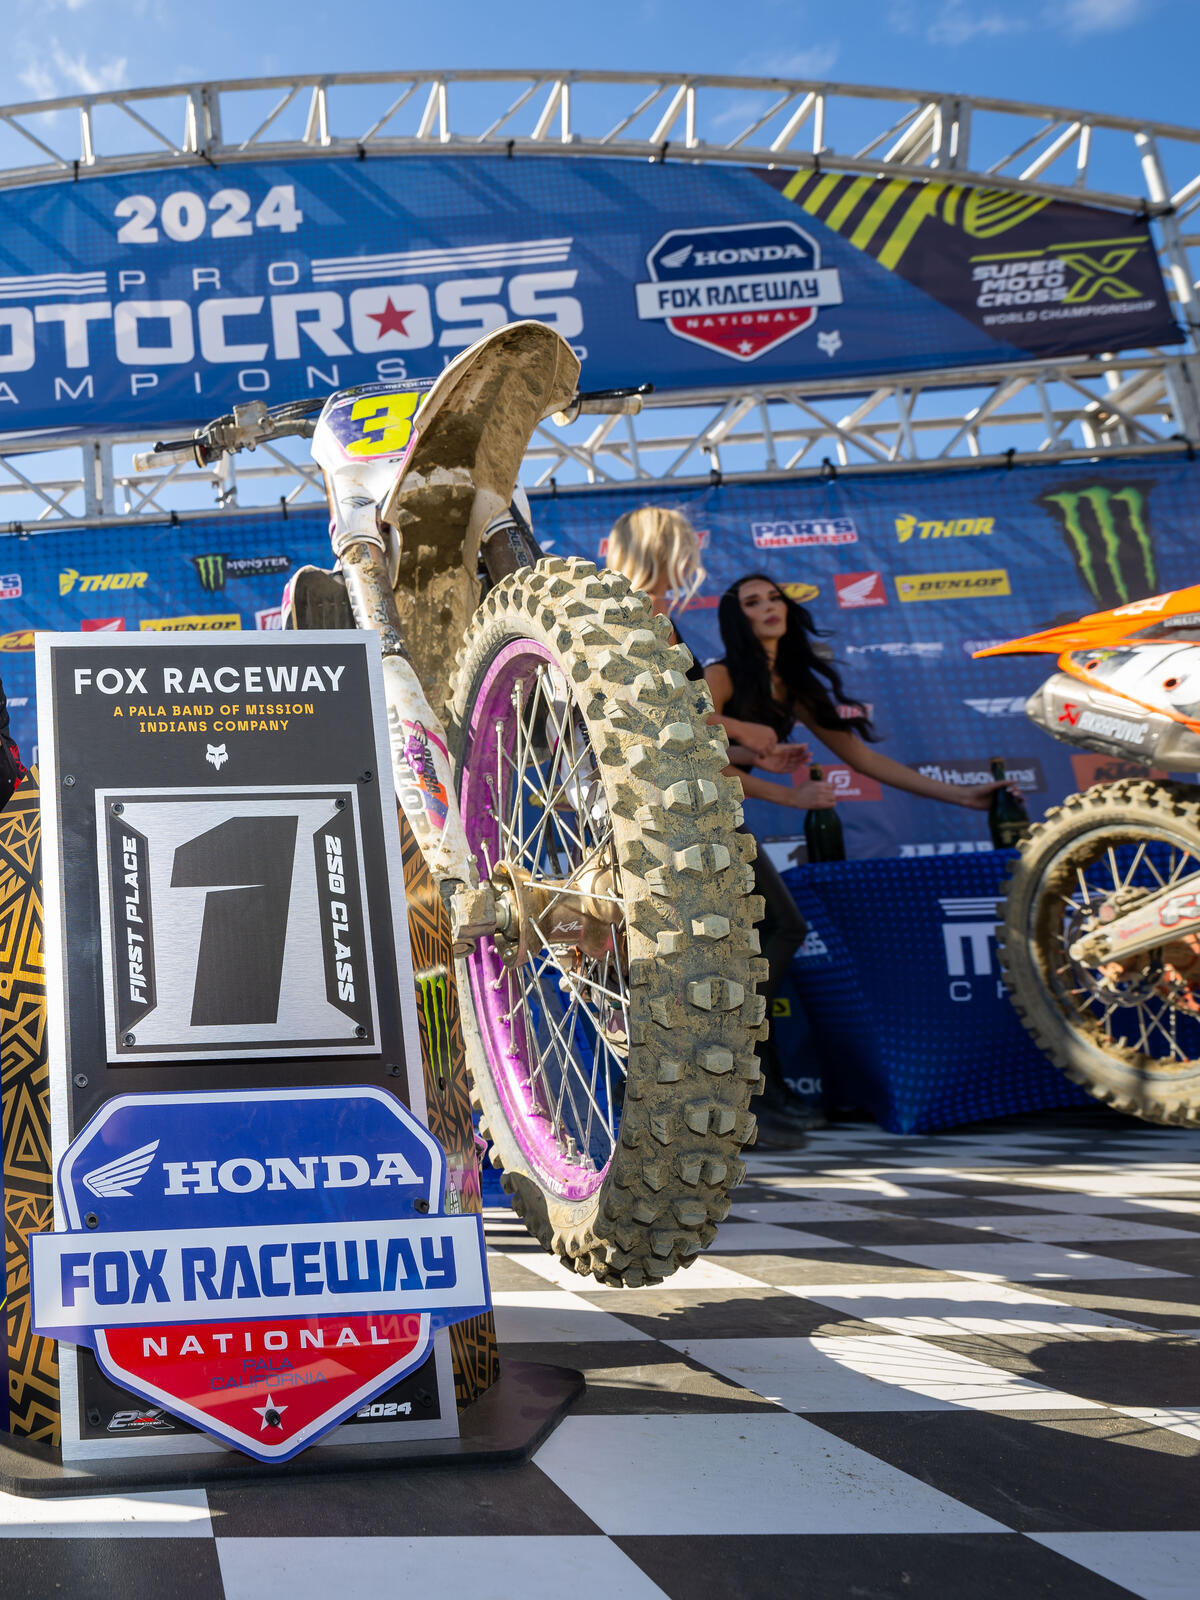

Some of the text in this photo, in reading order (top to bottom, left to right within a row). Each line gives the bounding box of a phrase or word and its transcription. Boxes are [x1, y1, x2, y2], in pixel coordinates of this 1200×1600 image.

[114, 185, 302, 243] 2024
[694, 244, 808, 267] HONDA
[119, 261, 300, 292] PRO
[972, 259, 1067, 281] SUPER
[658, 277, 820, 310] FOX RACEWAY
[981, 274, 1065, 294] MOTO
[977, 287, 1069, 308] CROSS
[687, 311, 799, 329] NATIONAL
[984, 300, 1156, 326] WORLD CHAMPIONSHIP
[345, 391, 426, 456] 3
[754, 518, 854, 537] PARTS
[919, 518, 996, 539] THOR
[756, 533, 858, 548] UNLIMITED
[227, 557, 289, 569] MONSTER
[79, 572, 148, 592] THOR
[919, 577, 1003, 591] DUNLOP
[74, 665, 346, 695] FOX RACEWAY
[113, 703, 315, 717] A PALA BAND OF MISSION
[139, 719, 289, 733] INDIANS COMPANY
[122, 835, 148, 1005] FIRST PLACE
[170, 815, 299, 1027] 1
[325, 834, 356, 1003] 250 CLASS
[163, 1153, 424, 1196] HONDA
[60, 1236, 458, 1307] FOX RACEWAY
[143, 1326, 390, 1357] NATIONAL
[242, 1358, 294, 1372] PALA
[210, 1371, 328, 1390] CALIFORNIA
[356, 1401, 412, 1418] 2024
